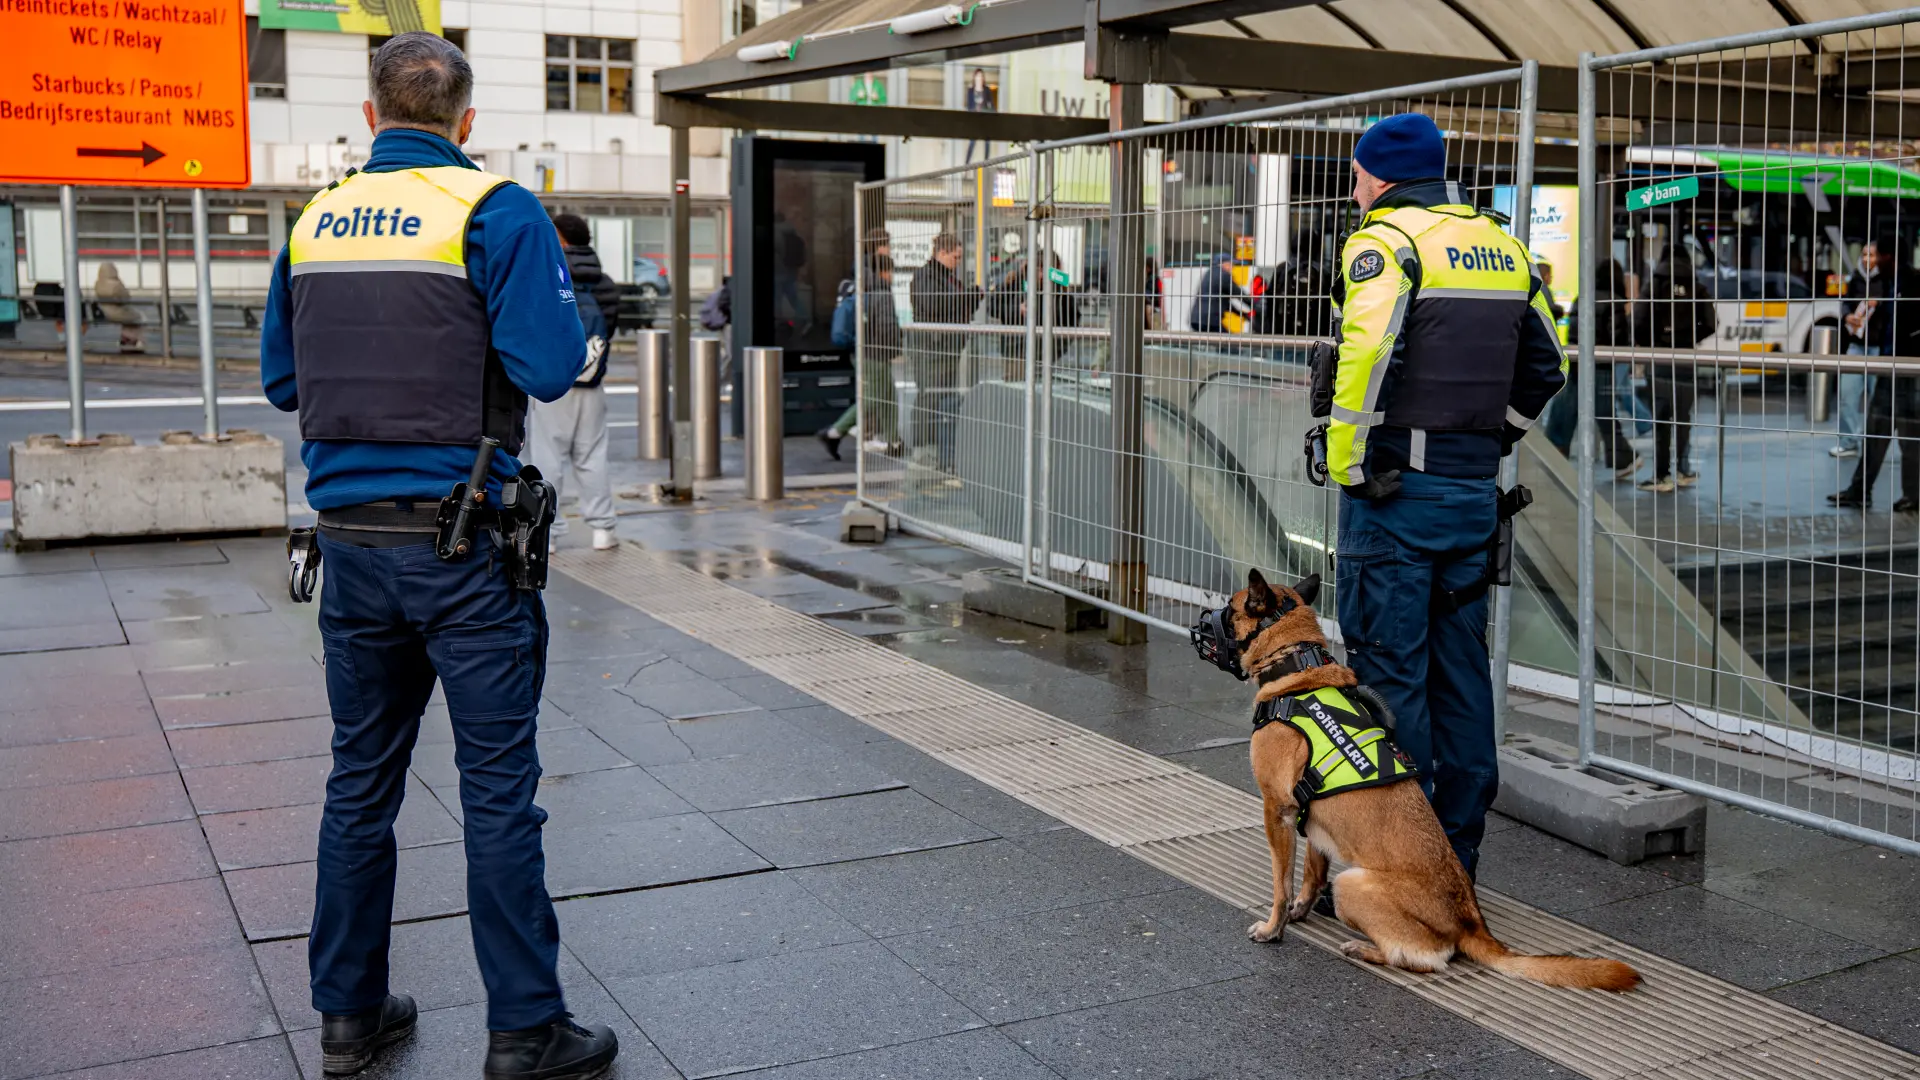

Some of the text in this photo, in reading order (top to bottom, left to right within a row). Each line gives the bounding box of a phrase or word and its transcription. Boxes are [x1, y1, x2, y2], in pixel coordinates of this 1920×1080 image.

[124, 1, 217, 25] Wachtzaal
[70, 26, 99, 46] WC
[114, 28, 162, 54] Relay
[32, 73, 125, 96] Starbucks
[140, 78, 193, 99] Panos
[0, 100, 235, 128] Bedrijfsrestaurant NMBS
[1655, 185, 1680, 200] bam
[314, 206, 422, 239] Politie
[1445, 245, 1516, 272] Politie
[1308, 702, 1370, 771] Politie LRH
